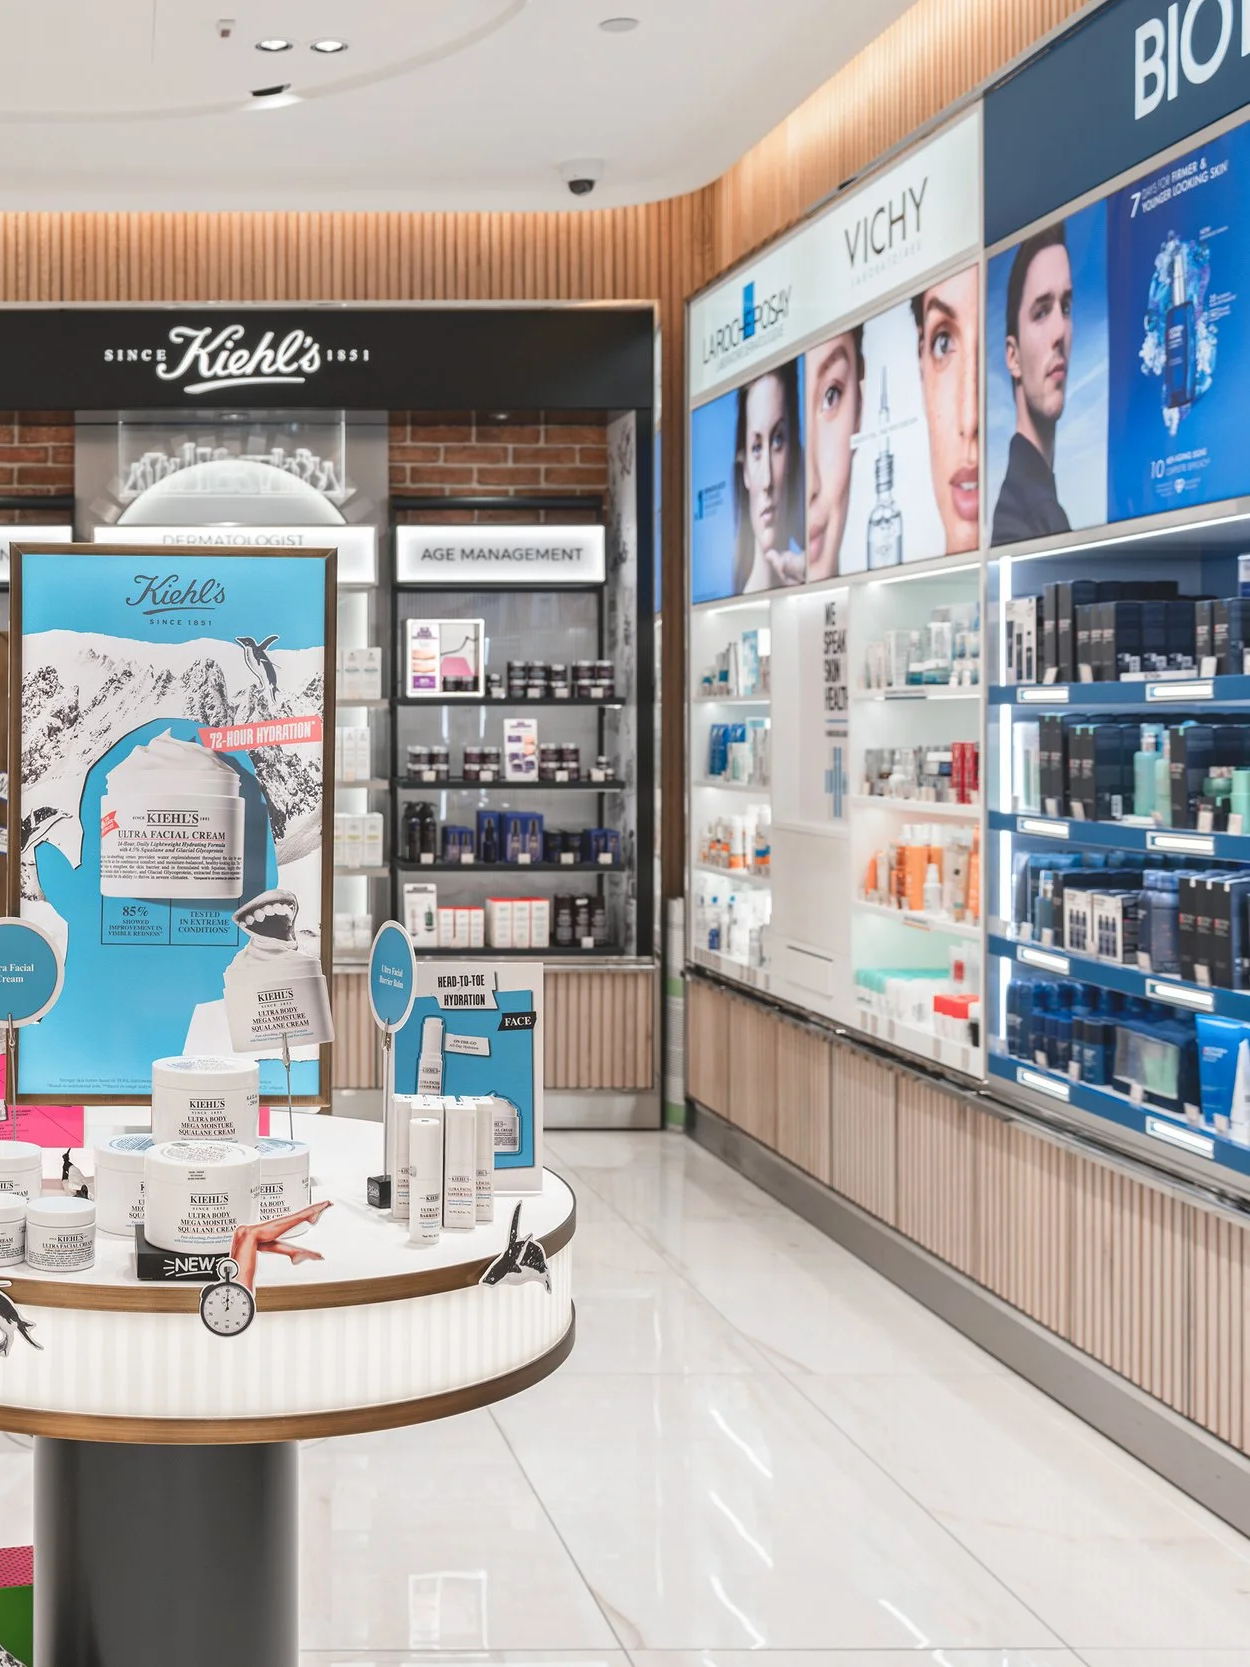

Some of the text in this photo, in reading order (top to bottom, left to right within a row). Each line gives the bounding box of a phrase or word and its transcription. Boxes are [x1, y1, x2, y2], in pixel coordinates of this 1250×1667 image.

[1141, 187, 1172, 213] YOUNGER
[1172, 170, 1209, 197] LOOKING
[1130, 192, 1142, 218] 7
[844, 176, 928, 268] VICHY
[104, 324, 370, 381] SINCE Kiehl's 1851
[1150, 459, 1165, 479] 10
[162, 534, 305, 546] DERMATOLOGIST
[420, 547, 584, 562] AGE MANAGEMENT
[125, 574, 226, 606] Kiehl's
[209, 728, 254, 749] 72-HOUR
[146, 813, 199, 824] KIEHL'S
[117, 830, 226, 840] ULTRA FACIAL CREAM
[122, 905, 149, 917] 85%
[9, 963, 34, 972] Facial
[381, 964, 403, 977] Ultra Facial
[379, 975, 404, 989] Barrier Balm
[437, 974, 485, 988] HEAD-TO-TOE
[257, 990, 294, 1002] KIEHL'S
[443, 993, 486, 1006] HYDRATION
[258, 1006, 298, 1017] ULTRA BODY
[252, 1012, 306, 1025] MEGA MOISTURE
[504, 1016, 532, 1027] FACE
[251, 1019, 310, 1033] SQUALANE CREAM
[189, 1100, 226, 1109] KIEHL'S
[178, 1128, 213, 1136] SQUALANE
[189, 1194, 229, 1204] KIEHL'S
[212, 1211, 231, 1219] BODY
[260, 1206, 291, 1214] MOISTURE
[177, 1225, 238, 1233] SQUALANE CREAM
[57, 1234, 84, 1242] KIEHL'S
[174, 1256, 216, 1272] NEW
